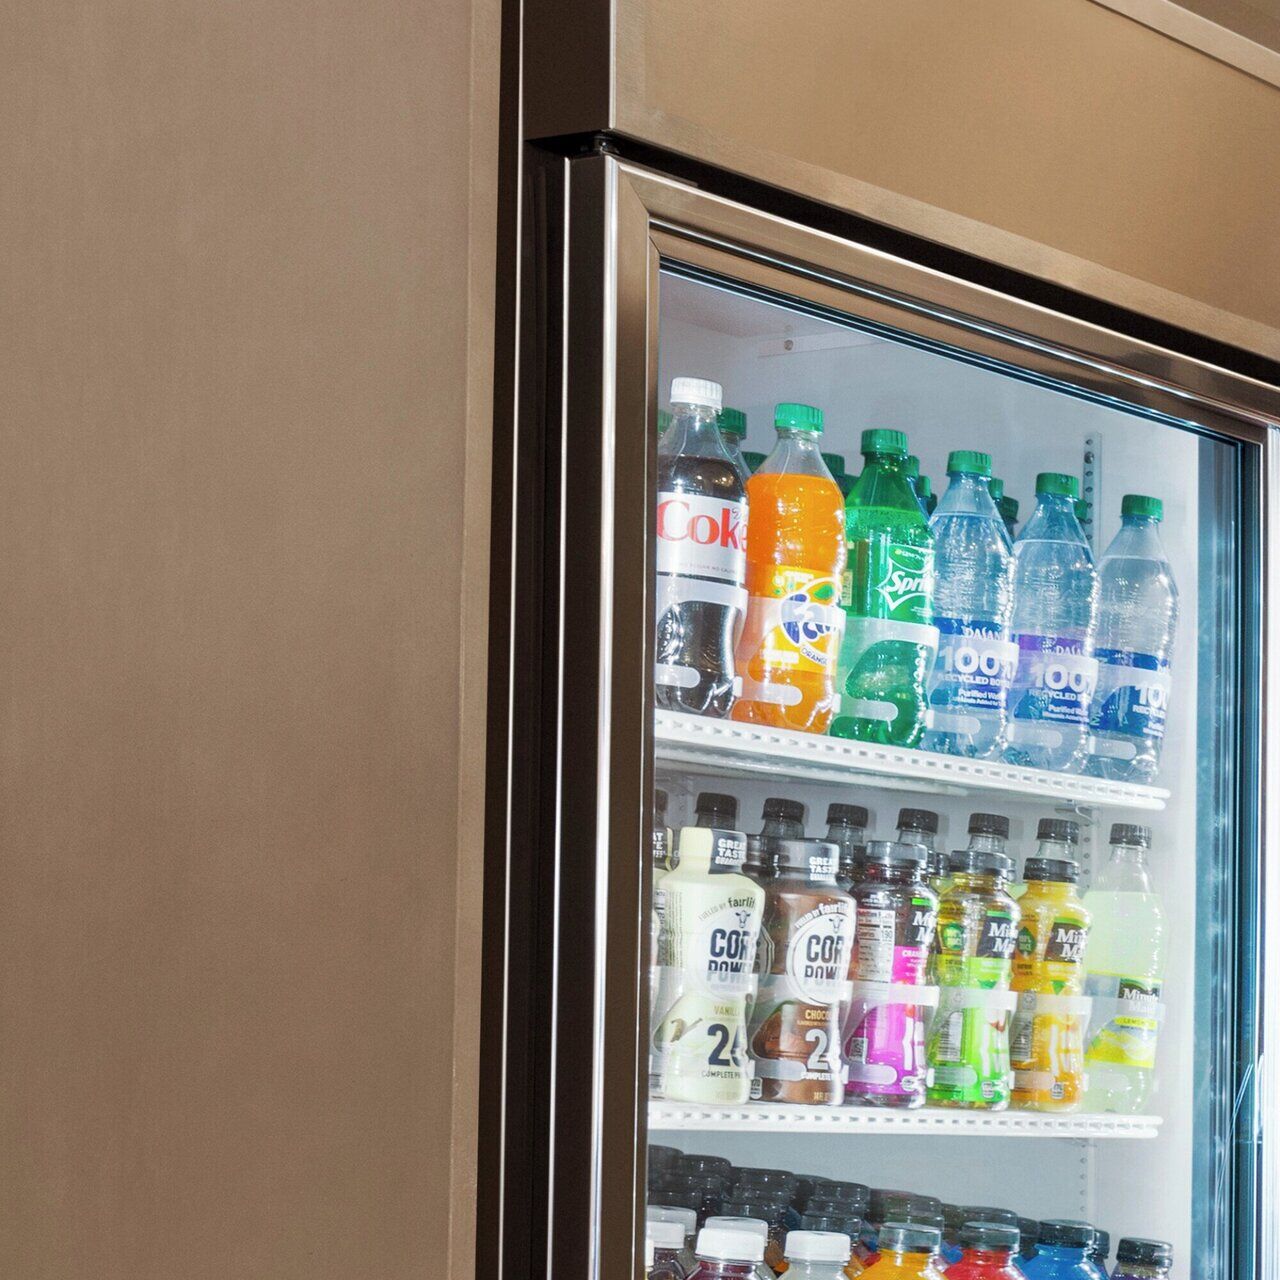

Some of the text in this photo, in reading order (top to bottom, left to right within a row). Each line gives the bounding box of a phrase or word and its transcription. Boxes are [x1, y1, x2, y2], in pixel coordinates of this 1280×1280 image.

[963, 626, 1002, 642] DASAN
[806, 934, 845, 963] COR
[707, 959, 752, 983] POW
